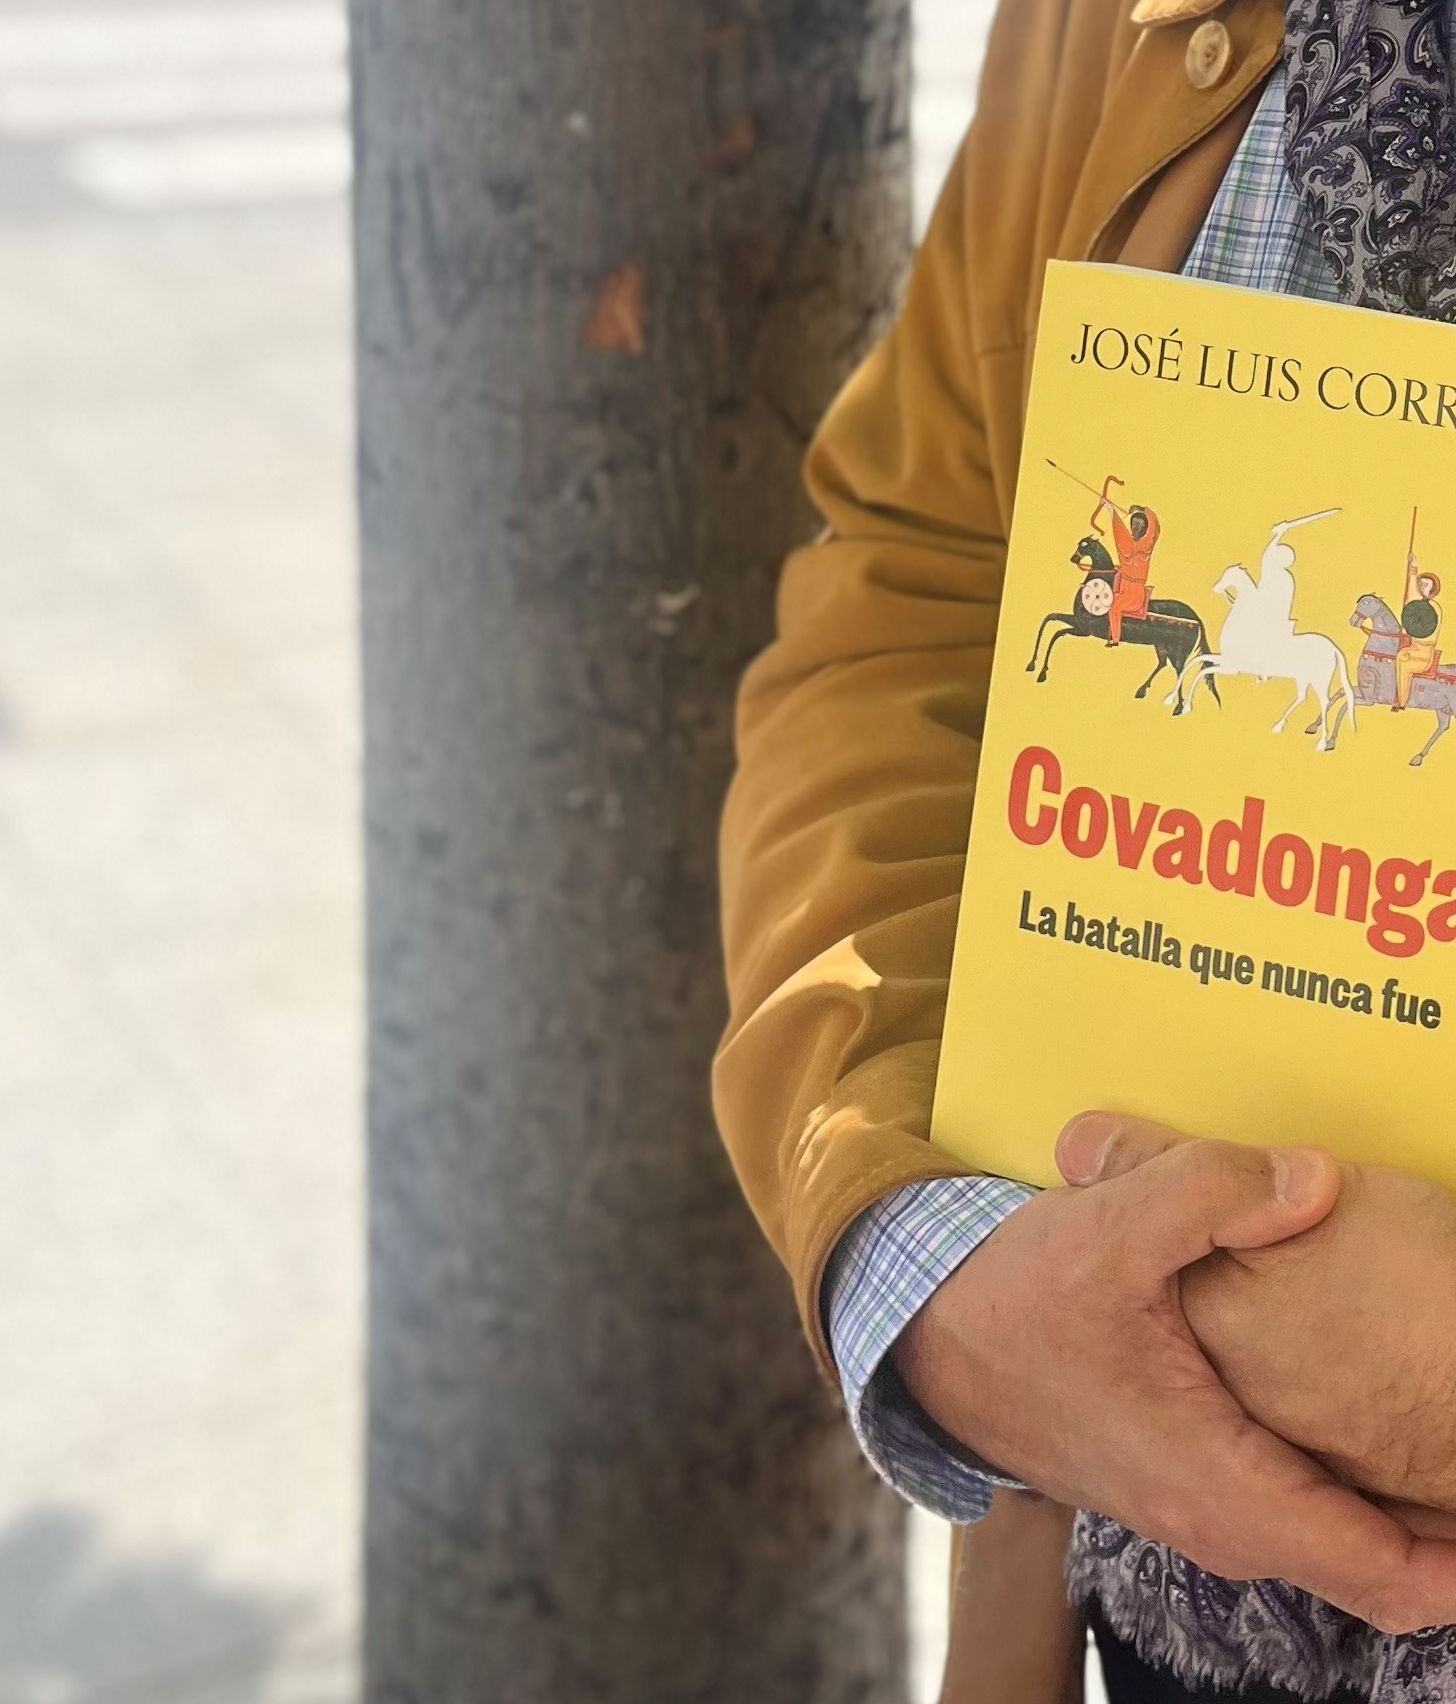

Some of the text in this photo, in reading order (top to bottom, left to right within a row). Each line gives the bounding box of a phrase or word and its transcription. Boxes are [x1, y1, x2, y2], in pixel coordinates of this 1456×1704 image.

[1070, 322, 1183, 382] JOSÉ
[1195, 343, 1302, 402] LUIS
[1018, 889, 1442, 1030] La batalla que nunca fue
